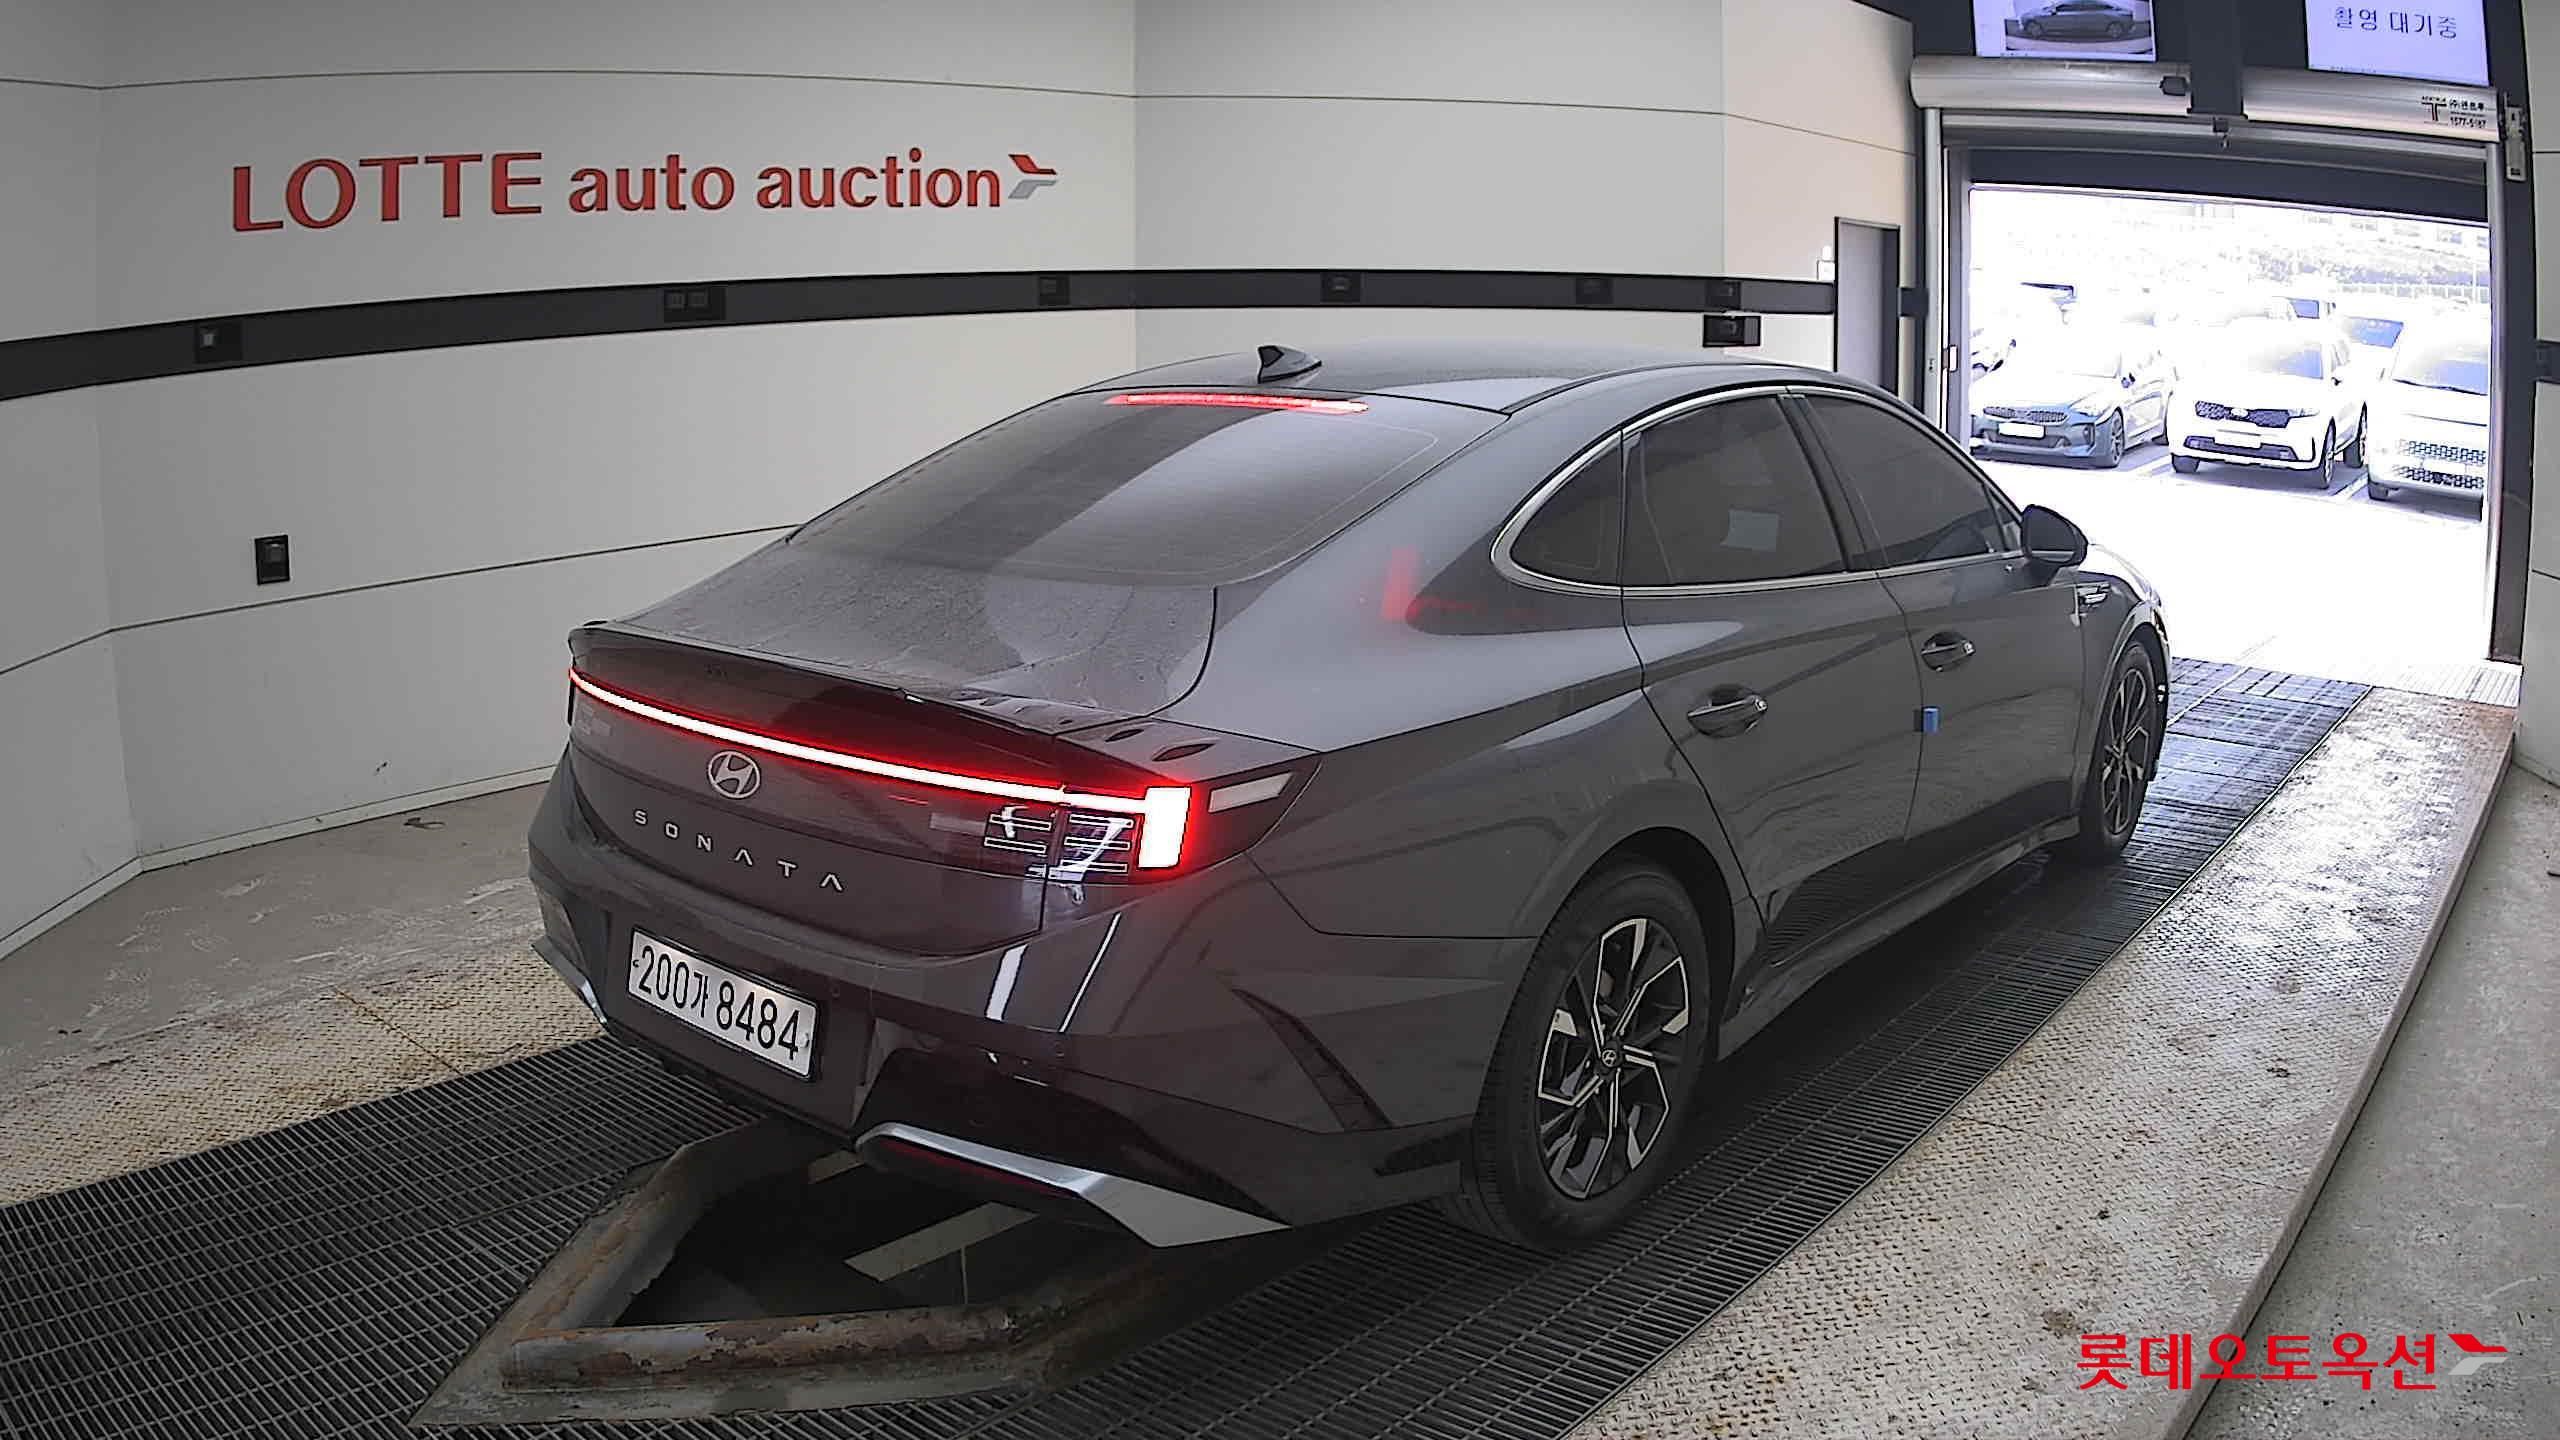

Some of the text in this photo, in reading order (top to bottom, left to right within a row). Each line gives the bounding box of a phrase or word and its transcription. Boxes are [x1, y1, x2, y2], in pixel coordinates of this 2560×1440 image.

[2389, 12, 2457, 39] 대기중
[233, 148, 1002, 232] LOTTE auto auction
[633, 809, 845, 893] SONATA
[716, 980, 800, 1061] 8484
